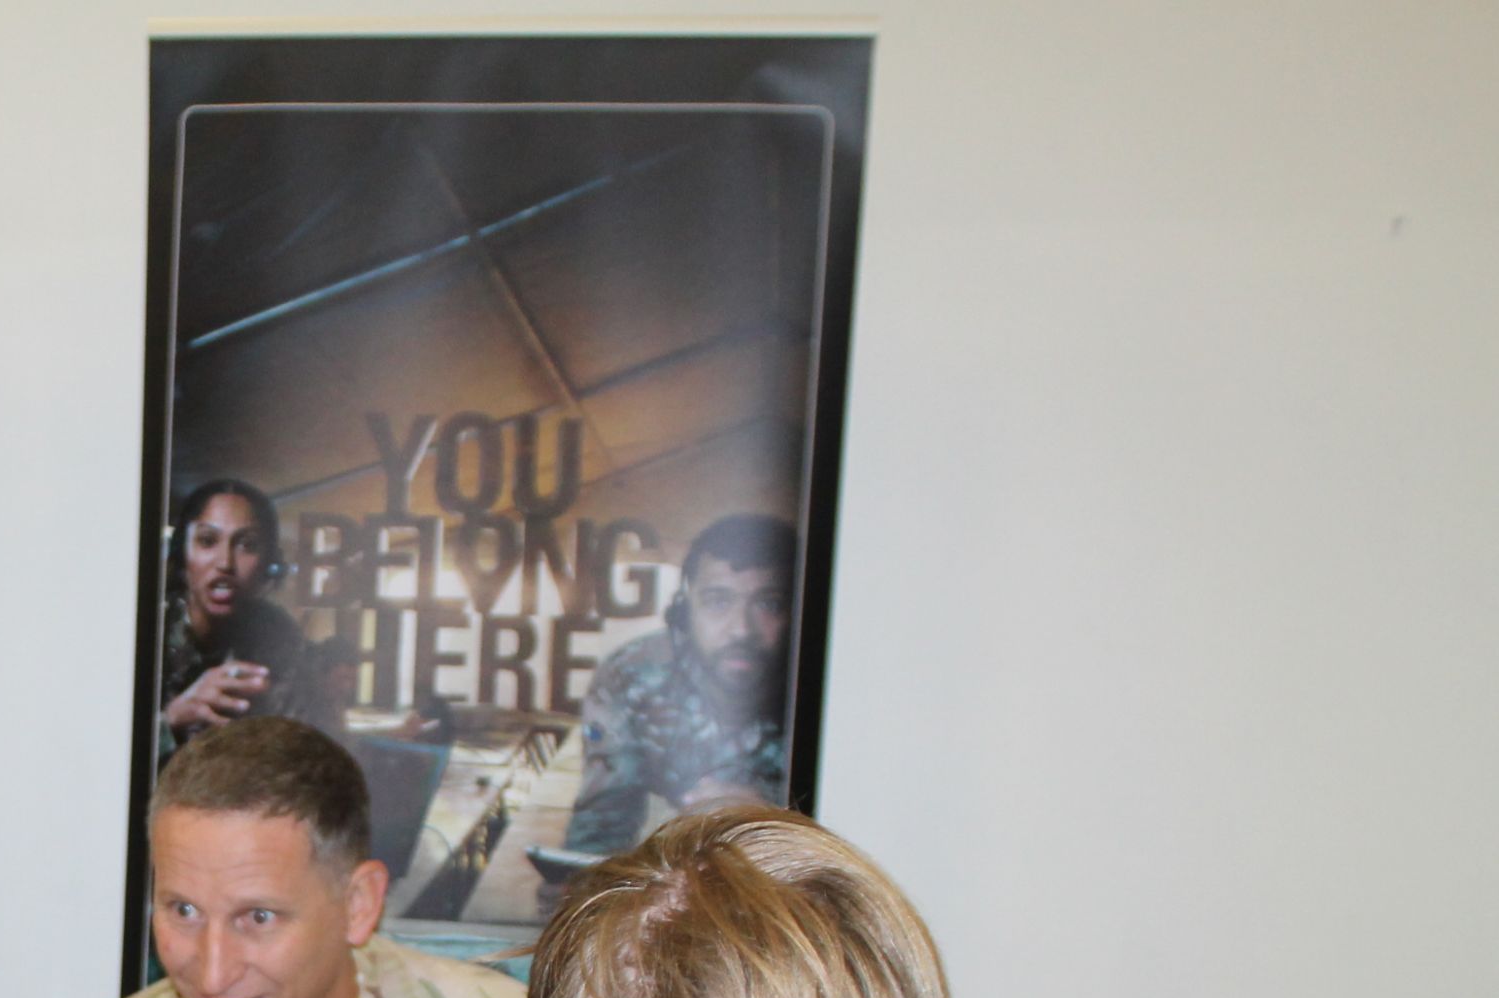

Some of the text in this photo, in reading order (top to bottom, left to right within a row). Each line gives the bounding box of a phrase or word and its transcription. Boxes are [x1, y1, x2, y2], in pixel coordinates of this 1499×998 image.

[366, 411, 585, 516] YOU
[301, 513, 665, 619] BELONG
[337, 608, 603, 714] HERE
